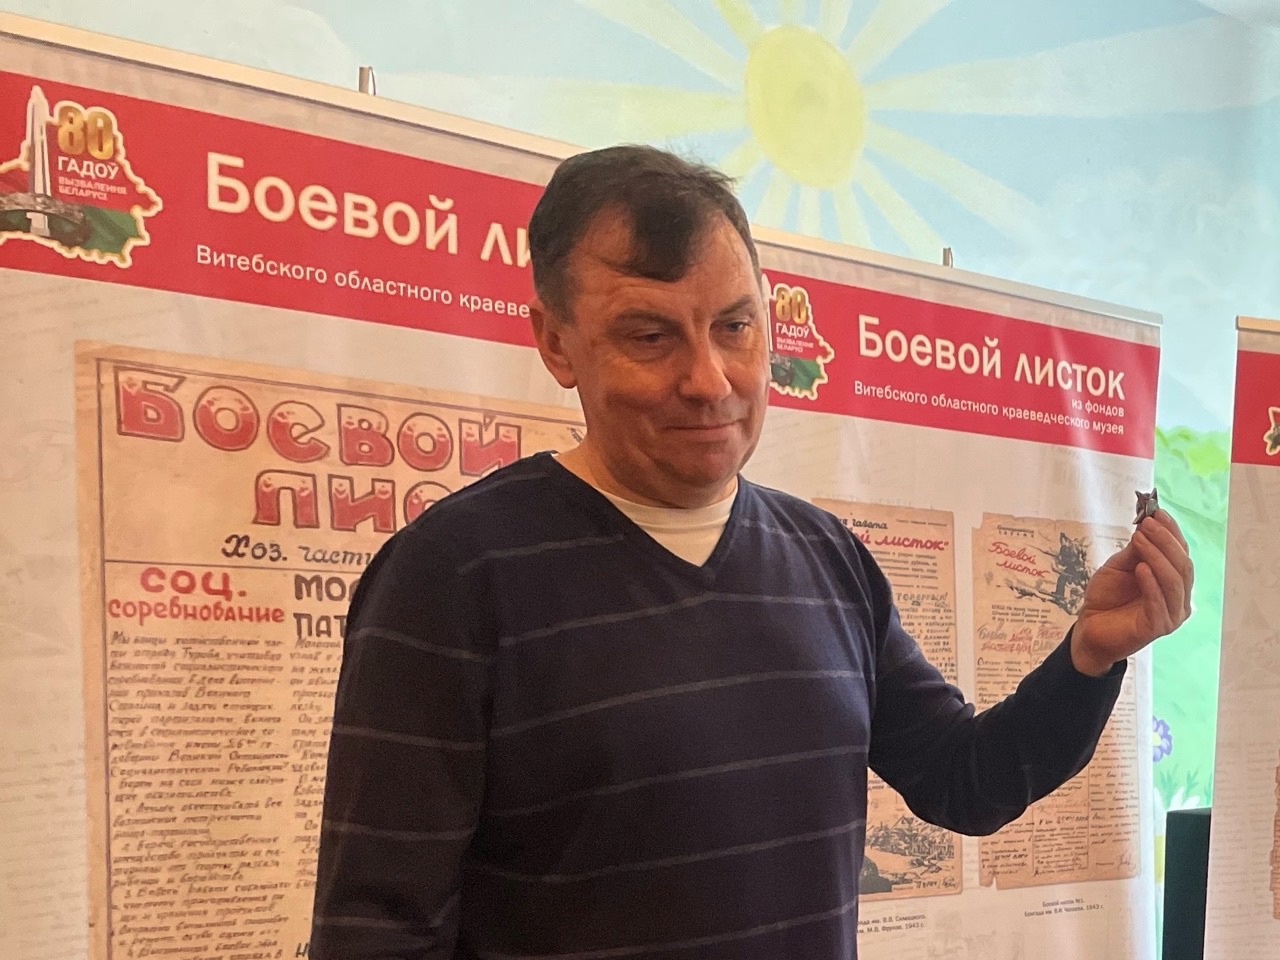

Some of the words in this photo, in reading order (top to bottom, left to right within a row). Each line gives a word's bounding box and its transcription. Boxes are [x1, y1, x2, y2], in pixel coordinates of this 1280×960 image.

[58, 106, 114, 160] 80
[58, 156, 119, 179] ГАДОЎ
[207, 152, 459, 254] Боевой
[196, 245, 327, 283] Витебского
[334, 269, 452, 304] областного
[775, 287, 807, 324] 80
[775, 322, 809, 338] ГАДОЎ
[858, 314, 1001, 379] Боевой
[1014, 353, 1125, 400] листок
[854, 381, 928, 404] Витебского
[931, 394, 999, 415] областного
[1002, 406, 1090, 429] краеведческого
[1093, 422, 1124, 435] музея
[1071, 399, 1082, 411] из
[1085, 403, 1125, 417] фондов
[988, 541, 1037, 565] Боевой
